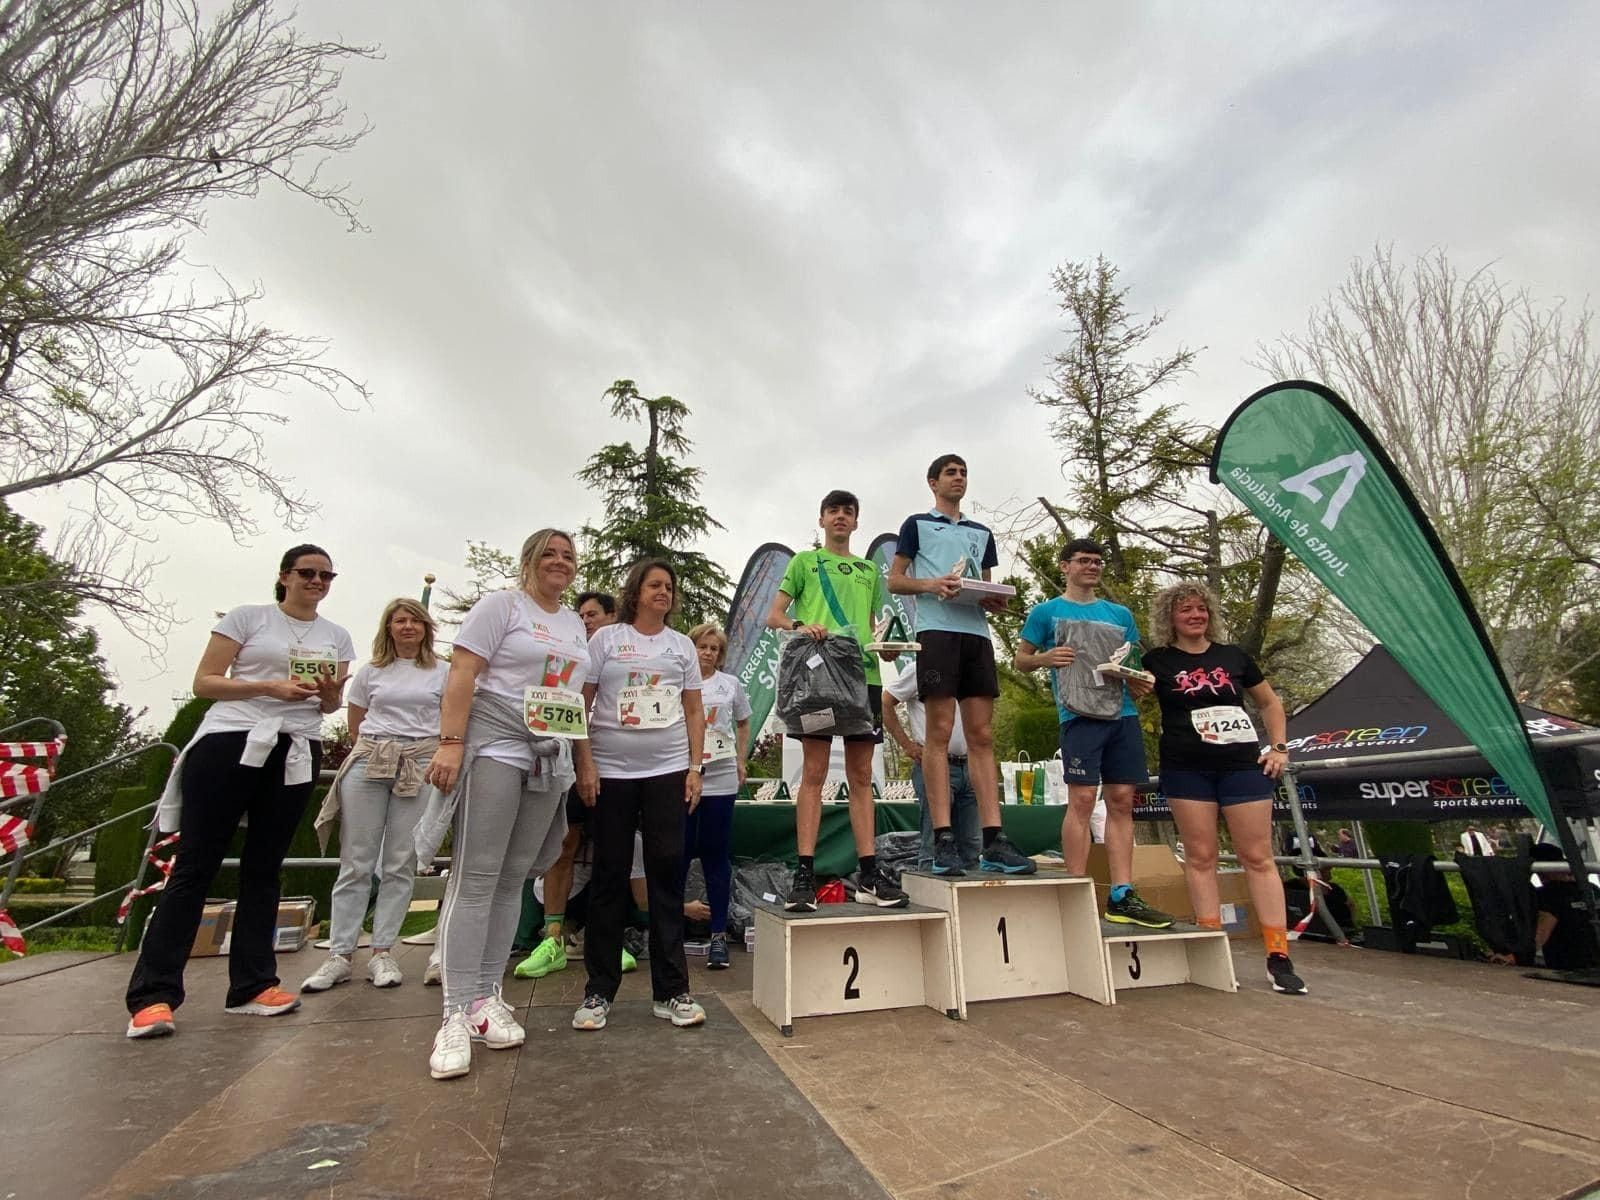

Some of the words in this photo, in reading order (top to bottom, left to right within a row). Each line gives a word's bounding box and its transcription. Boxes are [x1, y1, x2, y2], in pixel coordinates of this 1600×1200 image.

[543, 706, 582, 725] 5781
[652, 702, 661, 714] 1
[1210, 719, 1251, 733] 1243
[716, 739, 724, 749] 2
[1359, 776, 1516, 806] superscree
[1433, 797, 1525, 809] sport&event
[997, 916, 1010, 964] 1
[1124, 941, 1141, 980] 3
[843, 946, 860, 1000] 2
